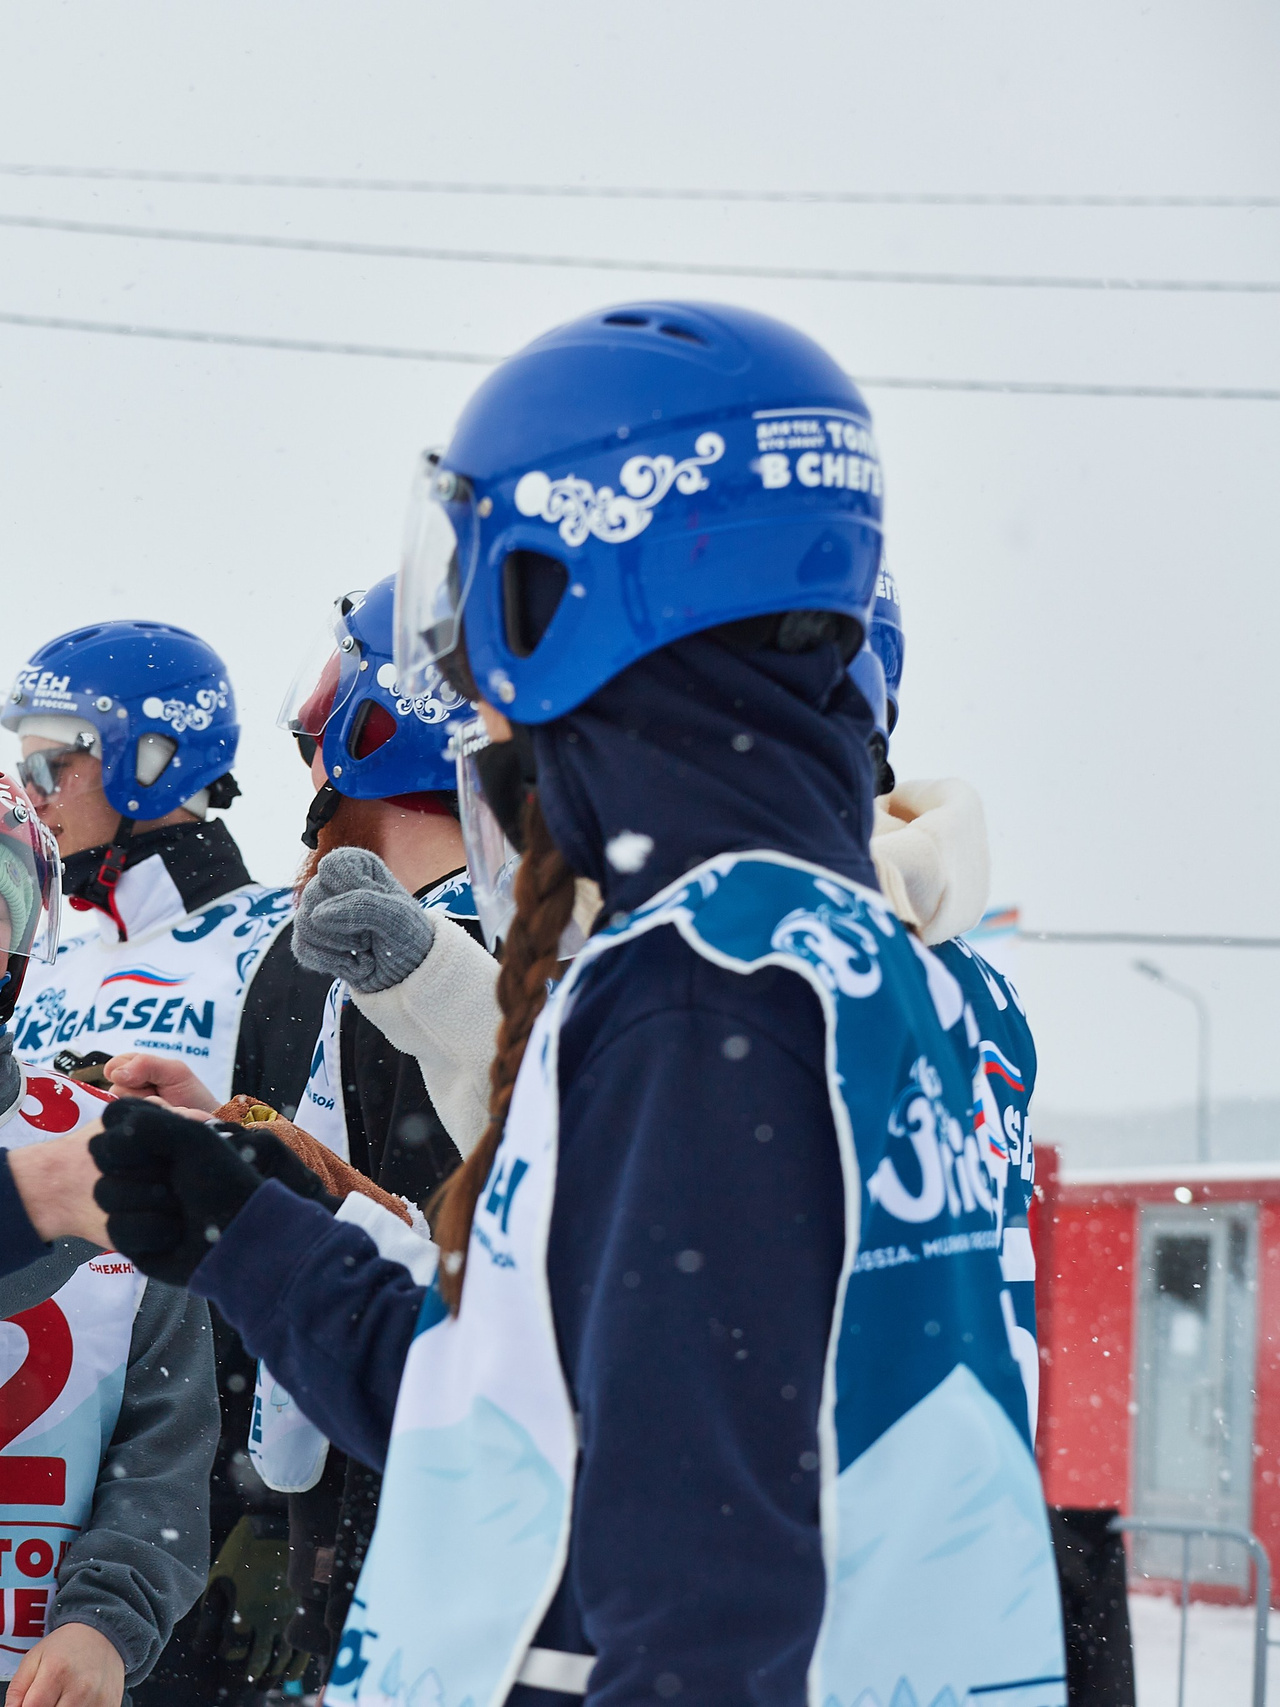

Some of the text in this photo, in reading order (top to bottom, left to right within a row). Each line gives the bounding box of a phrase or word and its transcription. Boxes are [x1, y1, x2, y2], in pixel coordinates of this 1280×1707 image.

[760, 453, 791, 489] В
[186, 1045, 209, 1056] БОЙ
[312, 1092, 335, 1111] БОЙ
